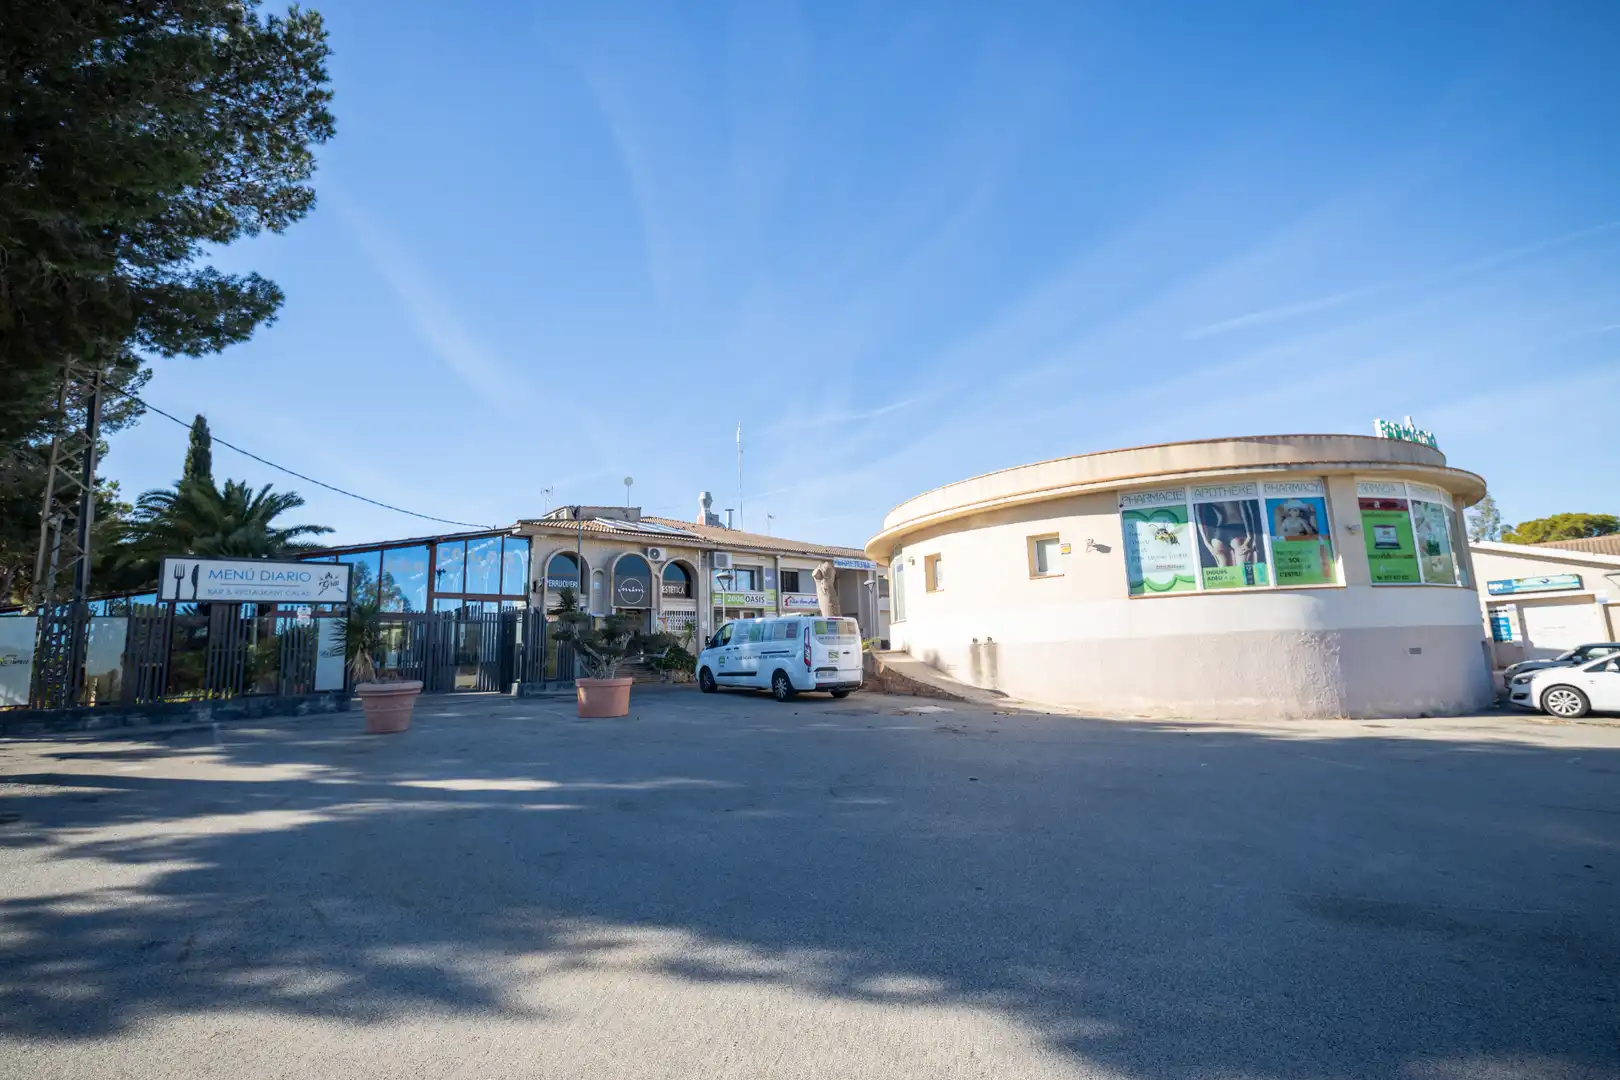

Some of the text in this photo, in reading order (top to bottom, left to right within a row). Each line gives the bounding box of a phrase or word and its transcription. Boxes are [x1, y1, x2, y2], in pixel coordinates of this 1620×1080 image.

[208, 567, 312, 583] MENÚ DIARIO
[207, 588, 225, 596] BAR
[745, 595, 765, 603] OASIS
